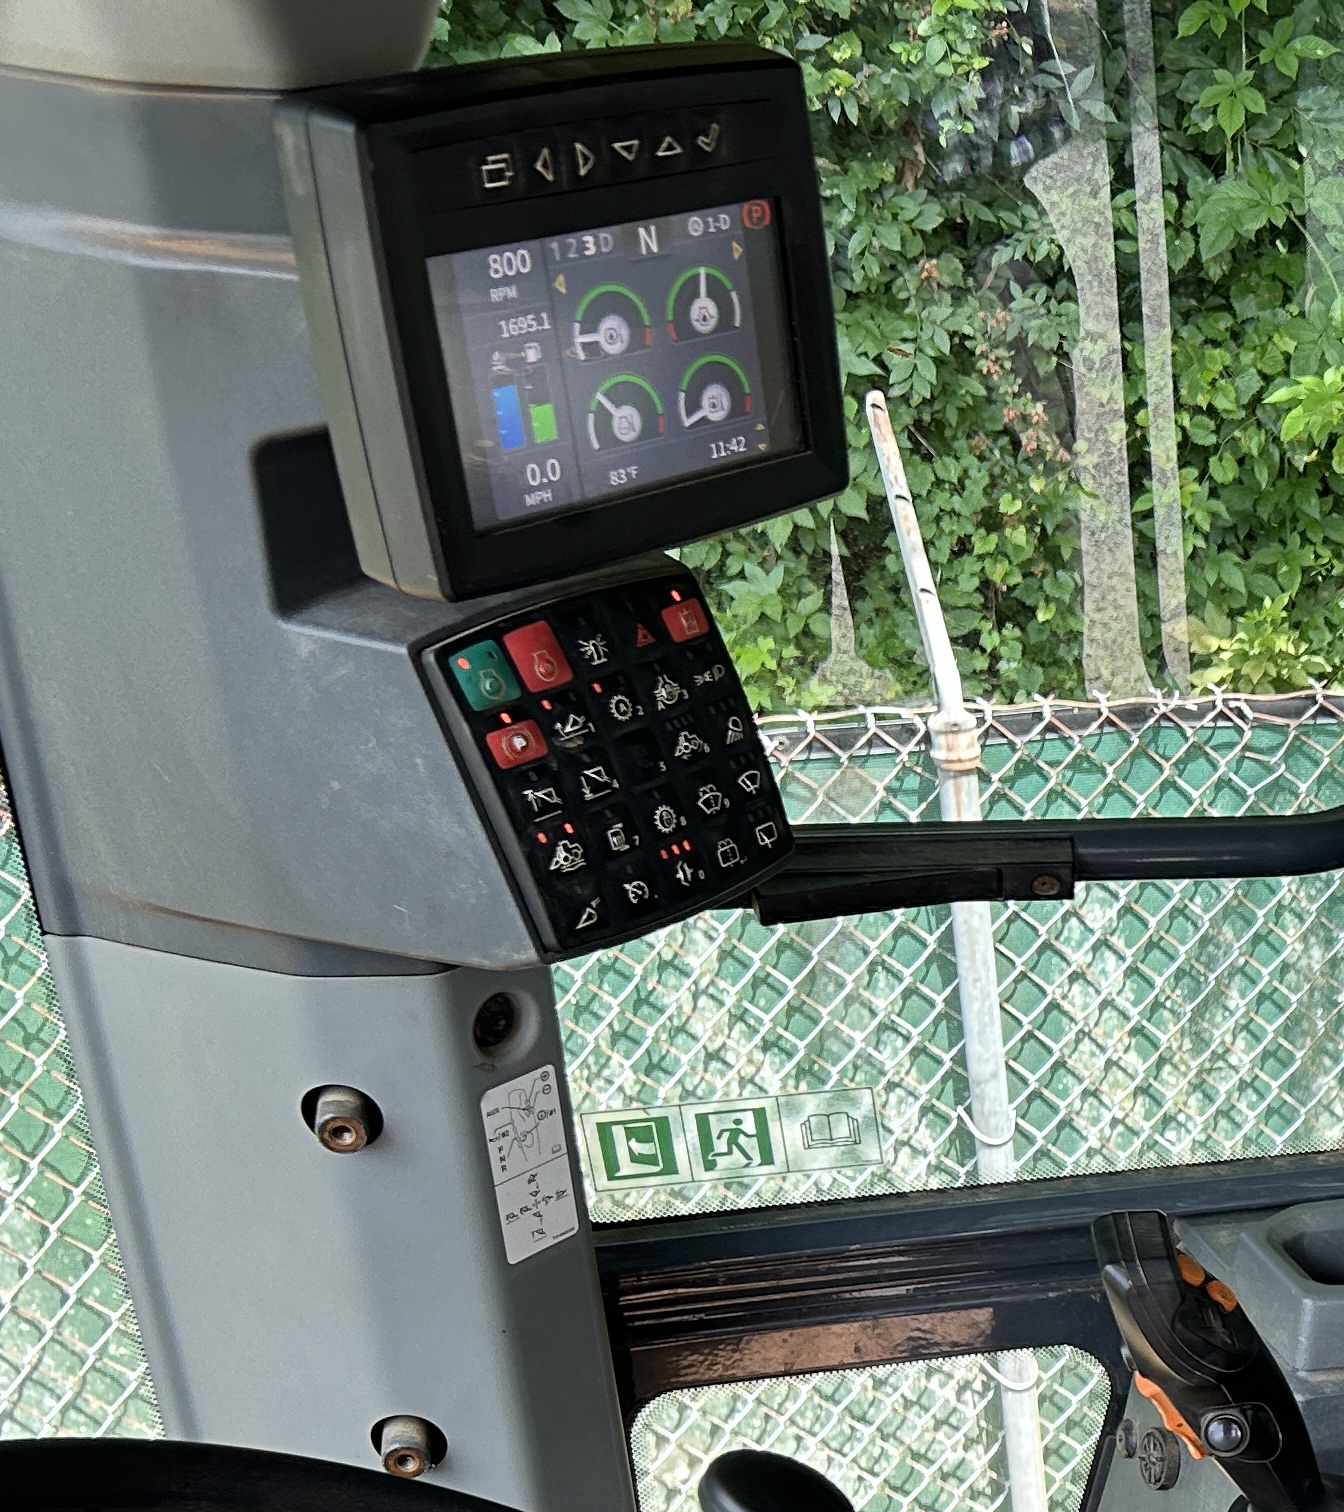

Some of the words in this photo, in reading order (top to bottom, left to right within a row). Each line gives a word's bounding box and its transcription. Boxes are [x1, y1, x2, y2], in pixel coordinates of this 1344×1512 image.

[582, 234, 597, 256] 3
[637, 224, 660, 256] N
[488, 248, 532, 279] 800
[489, 284, 519, 303] RPM
[498, 311, 552, 338] 1695.1
[709, 436, 748, 459] 11:42
[525, 457, 562, 487] 0.0
